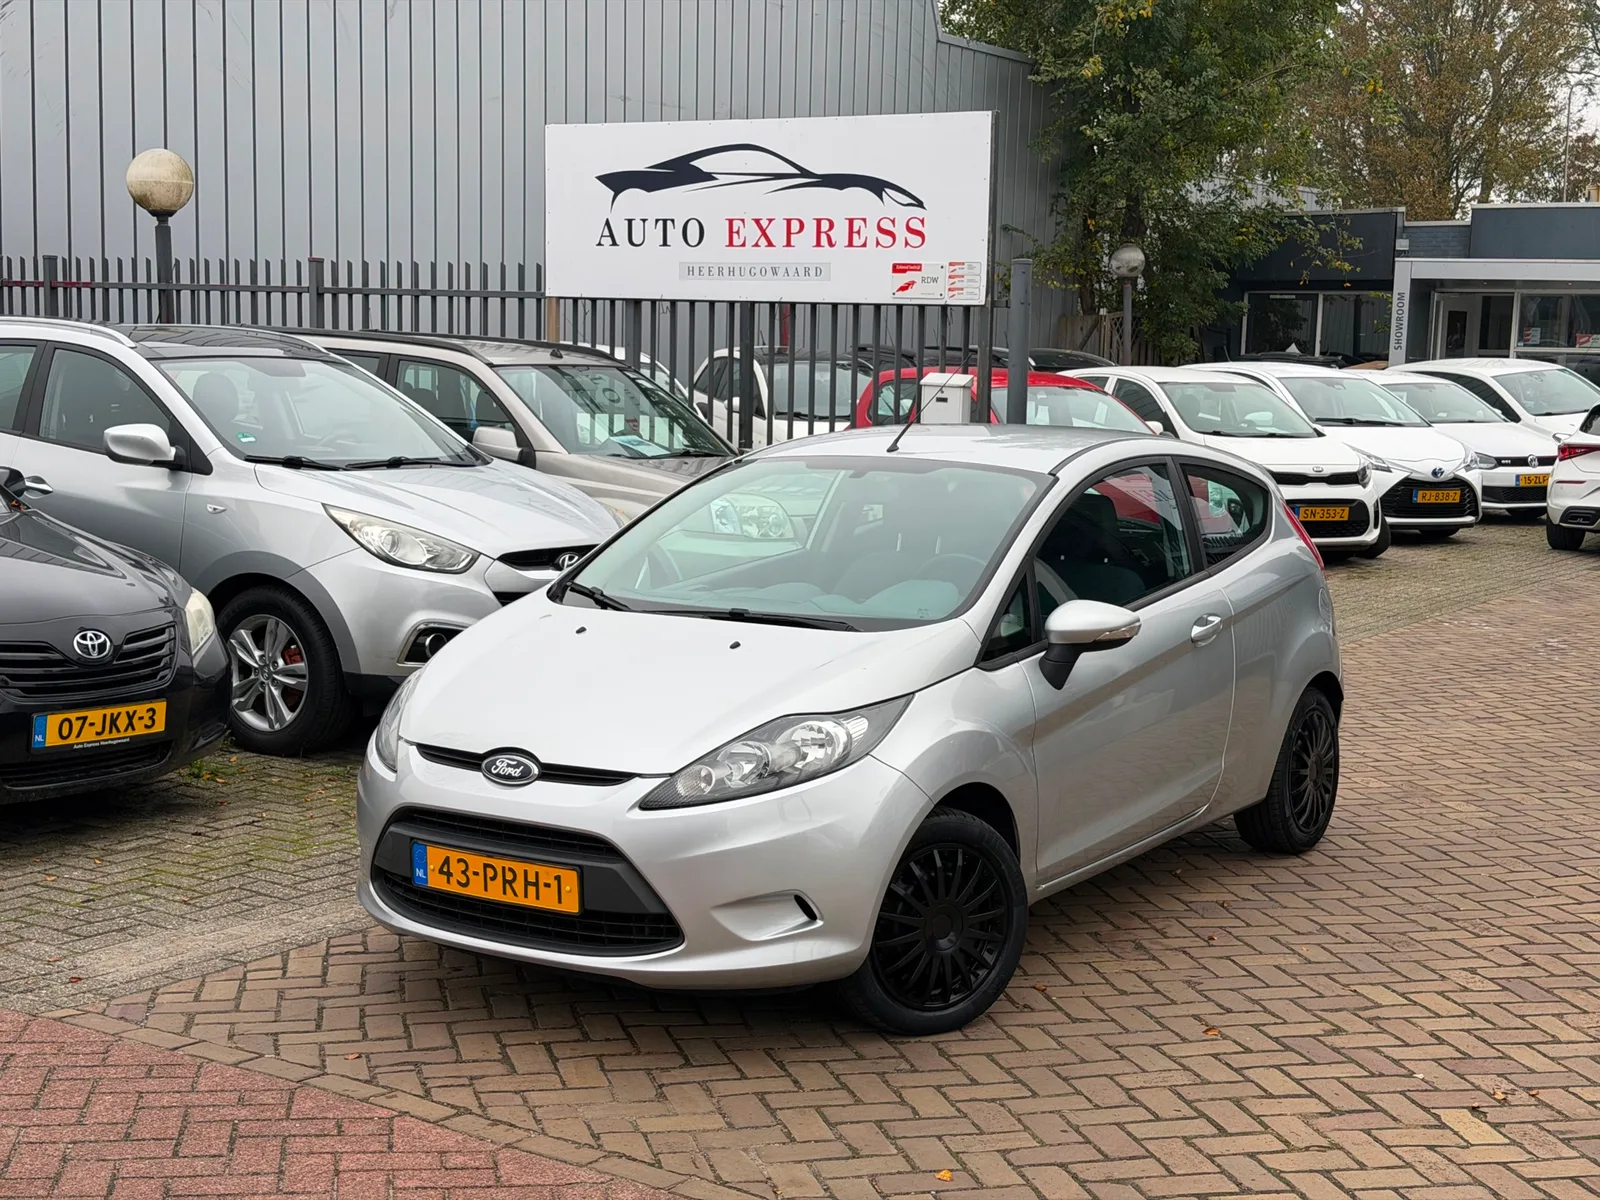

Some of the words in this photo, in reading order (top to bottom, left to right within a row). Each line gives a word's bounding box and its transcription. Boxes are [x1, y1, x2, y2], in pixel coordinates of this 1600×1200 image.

[595, 217, 705, 248] AUTO
[724, 216, 927, 249] EXPRESS
[686, 265, 823, 278] HEERHUGOWAARD
[920, 276, 940, 284] RDW
[1393, 292, 1406, 351] SHOWROOM
[1523, 475, 1550, 485] 15-ZLF-
[1421, 491, 1458, 502] RJ-838-Z
[1302, 508, 1346, 519] SN-353-Z
[34, 734, 45, 742] NL
[57, 707, 157, 741] 07-JKX-3
[491, 758, 525, 778] Ford
[415, 867, 427, 879] NL
[437, 855, 563, 905] 43-PRH-1
